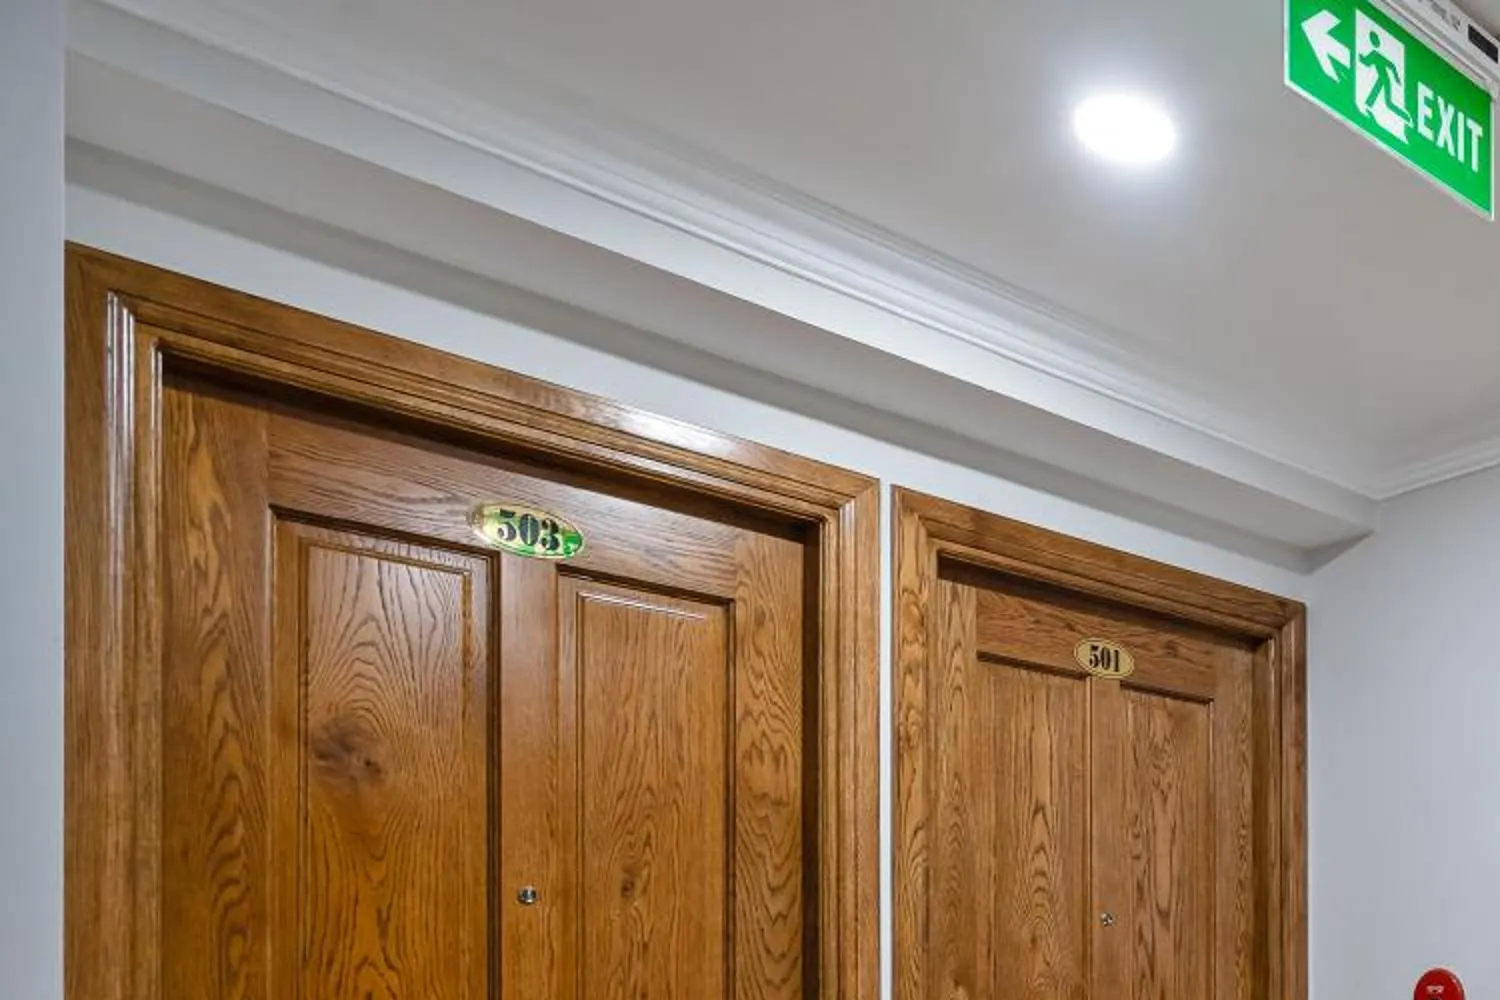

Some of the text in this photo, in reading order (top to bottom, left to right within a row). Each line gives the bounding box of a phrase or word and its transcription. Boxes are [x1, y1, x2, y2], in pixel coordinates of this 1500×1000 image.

[1416, 81, 1483, 173] EXIT
[497, 508, 560, 551] 503
[1089, 644, 1120, 673] 501
